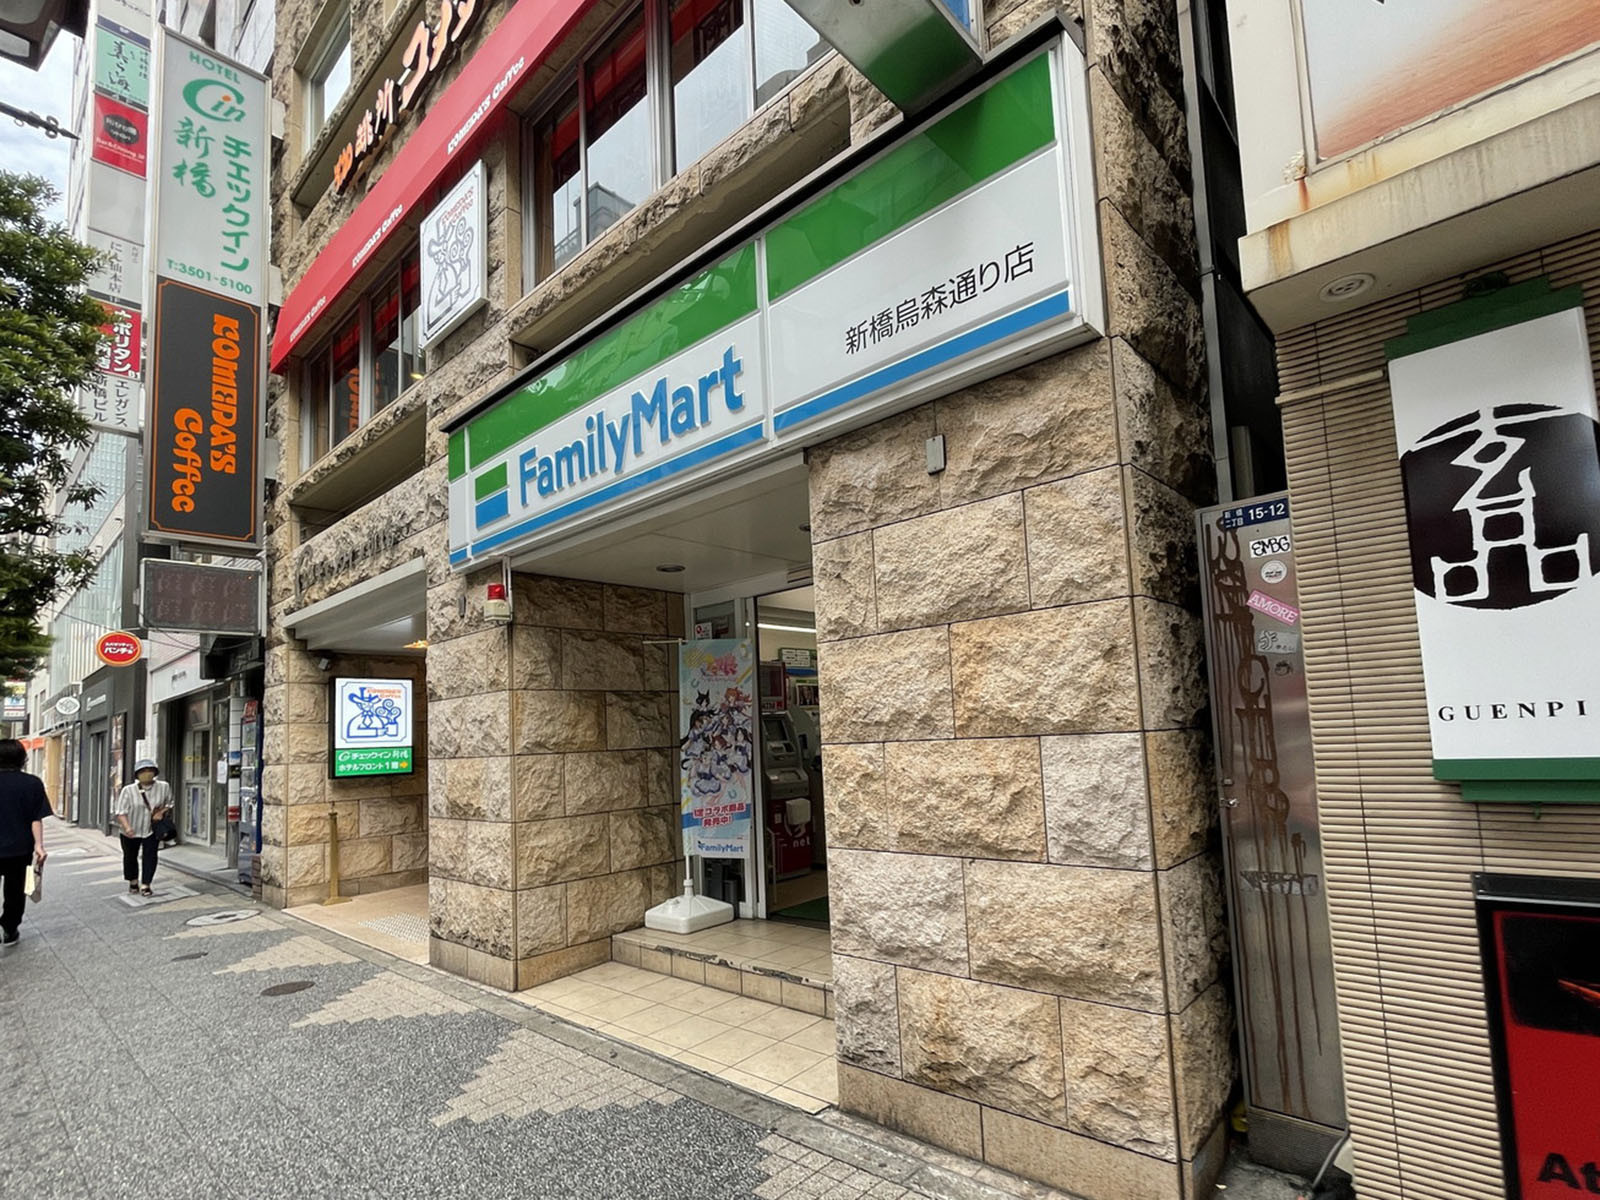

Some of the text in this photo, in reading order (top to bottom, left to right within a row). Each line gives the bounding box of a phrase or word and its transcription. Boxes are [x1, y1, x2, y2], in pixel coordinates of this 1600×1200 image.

[188, 51, 241, 84] HOTEL
[173, 116, 216, 198] 新橋
[166, 259, 252, 294] T:3501-5100
[844, 241, 1036, 356] 新橋烏森通り店
[113, 309, 133, 373] ナポリタン
[114, 380, 131, 428] エレガンス
[209, 313, 241, 474] KOMEDA'S
[518, 344, 746, 508] FamilyMart
[171, 407, 204, 513] Coffee
[1248, 503, 1286, 520] 15-12
[1248, 594, 1299, 623] AMORE
